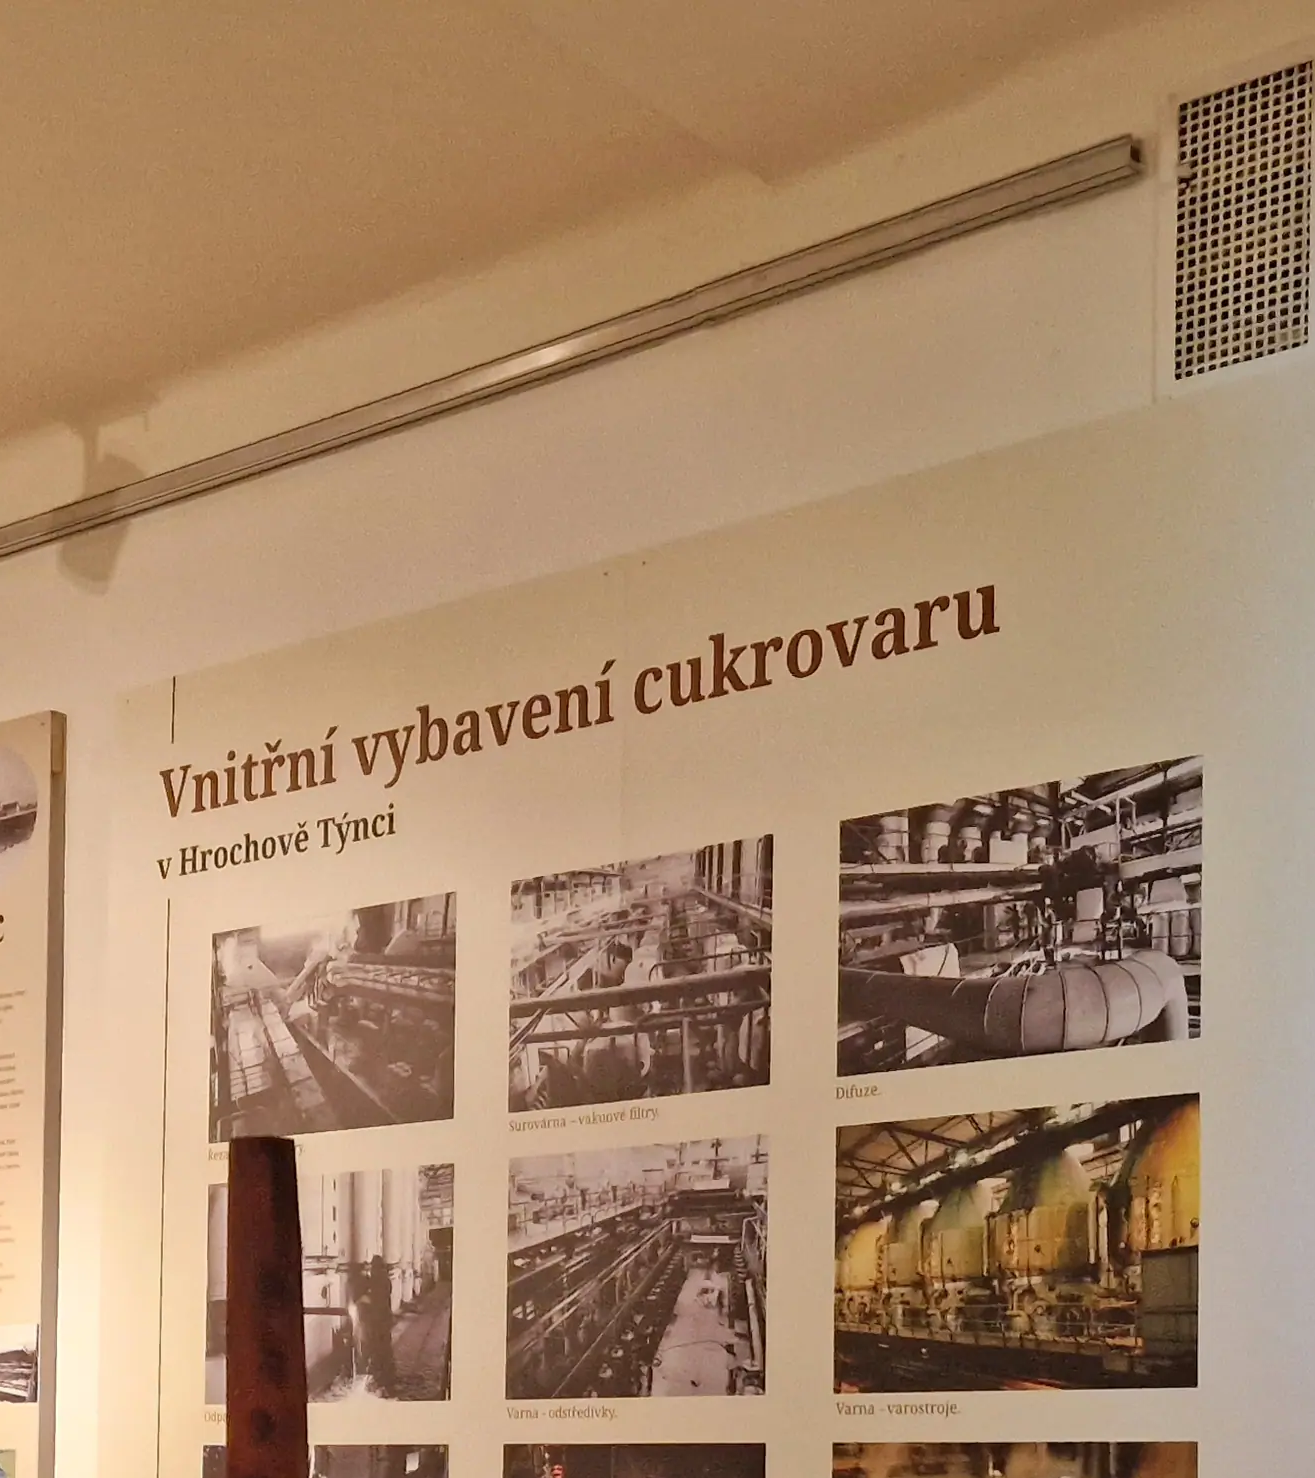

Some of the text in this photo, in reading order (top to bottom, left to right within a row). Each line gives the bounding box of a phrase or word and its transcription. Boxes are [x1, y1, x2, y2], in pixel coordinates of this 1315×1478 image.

[159, 584, 1000, 818] Vnitřní vybavení cukrovaru
[156, 804, 396, 880] v Hrochově Týnci
[509, 1117, 566, 1132] Surovárna
[578, 1107, 626, 1125] vakuové
[506, 1406, 538, 1420] Varna
[836, 1401, 875, 1416] Varna
